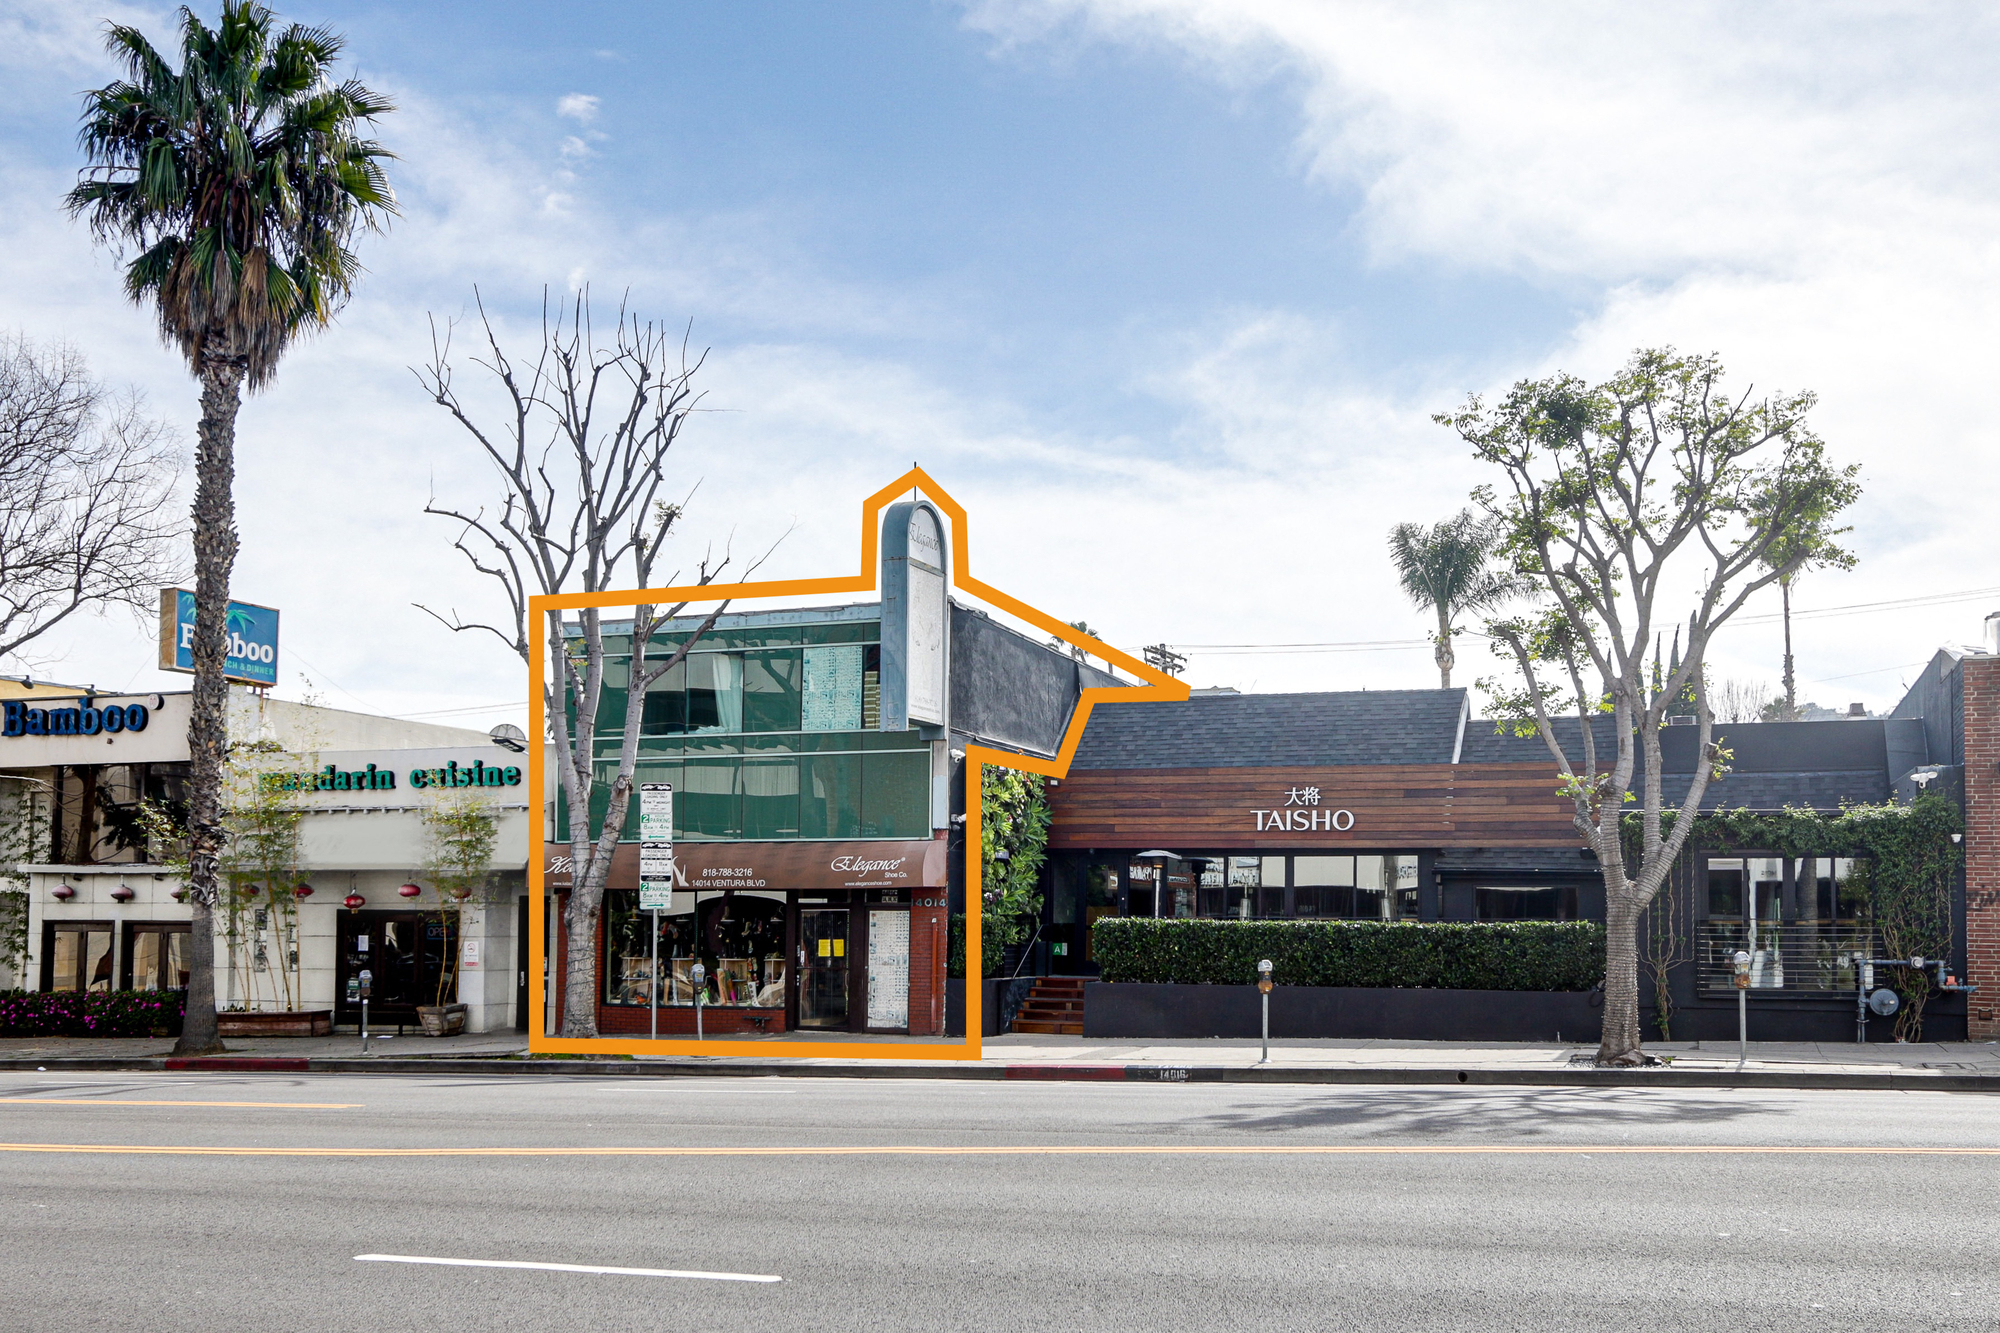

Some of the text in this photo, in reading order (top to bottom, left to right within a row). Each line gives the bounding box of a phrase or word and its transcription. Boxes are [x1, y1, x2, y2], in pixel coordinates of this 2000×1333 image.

[180, 622, 274, 664] Bboo
[240, 662, 246, 671] &
[246, 664, 274, 676] DINNER
[1, 696, 147, 736] Bamboo
[258, 760, 521, 790] andarin cuisine
[1284, 786, 1321, 806] 大将
[642, 814, 649, 823] 2
[1250, 809, 1355, 831] TAISHO
[702, 868, 753, 877] 818-788-3216
[831, 856, 901, 877] Elegance
[641, 883, 648, 891] 2
[692, 879, 766, 887] 14014 VENTURA BLVD
[911, 898, 947, 907] 14014
[428, 927, 451, 937] OPE
[1054, 945, 1061, 953] A
